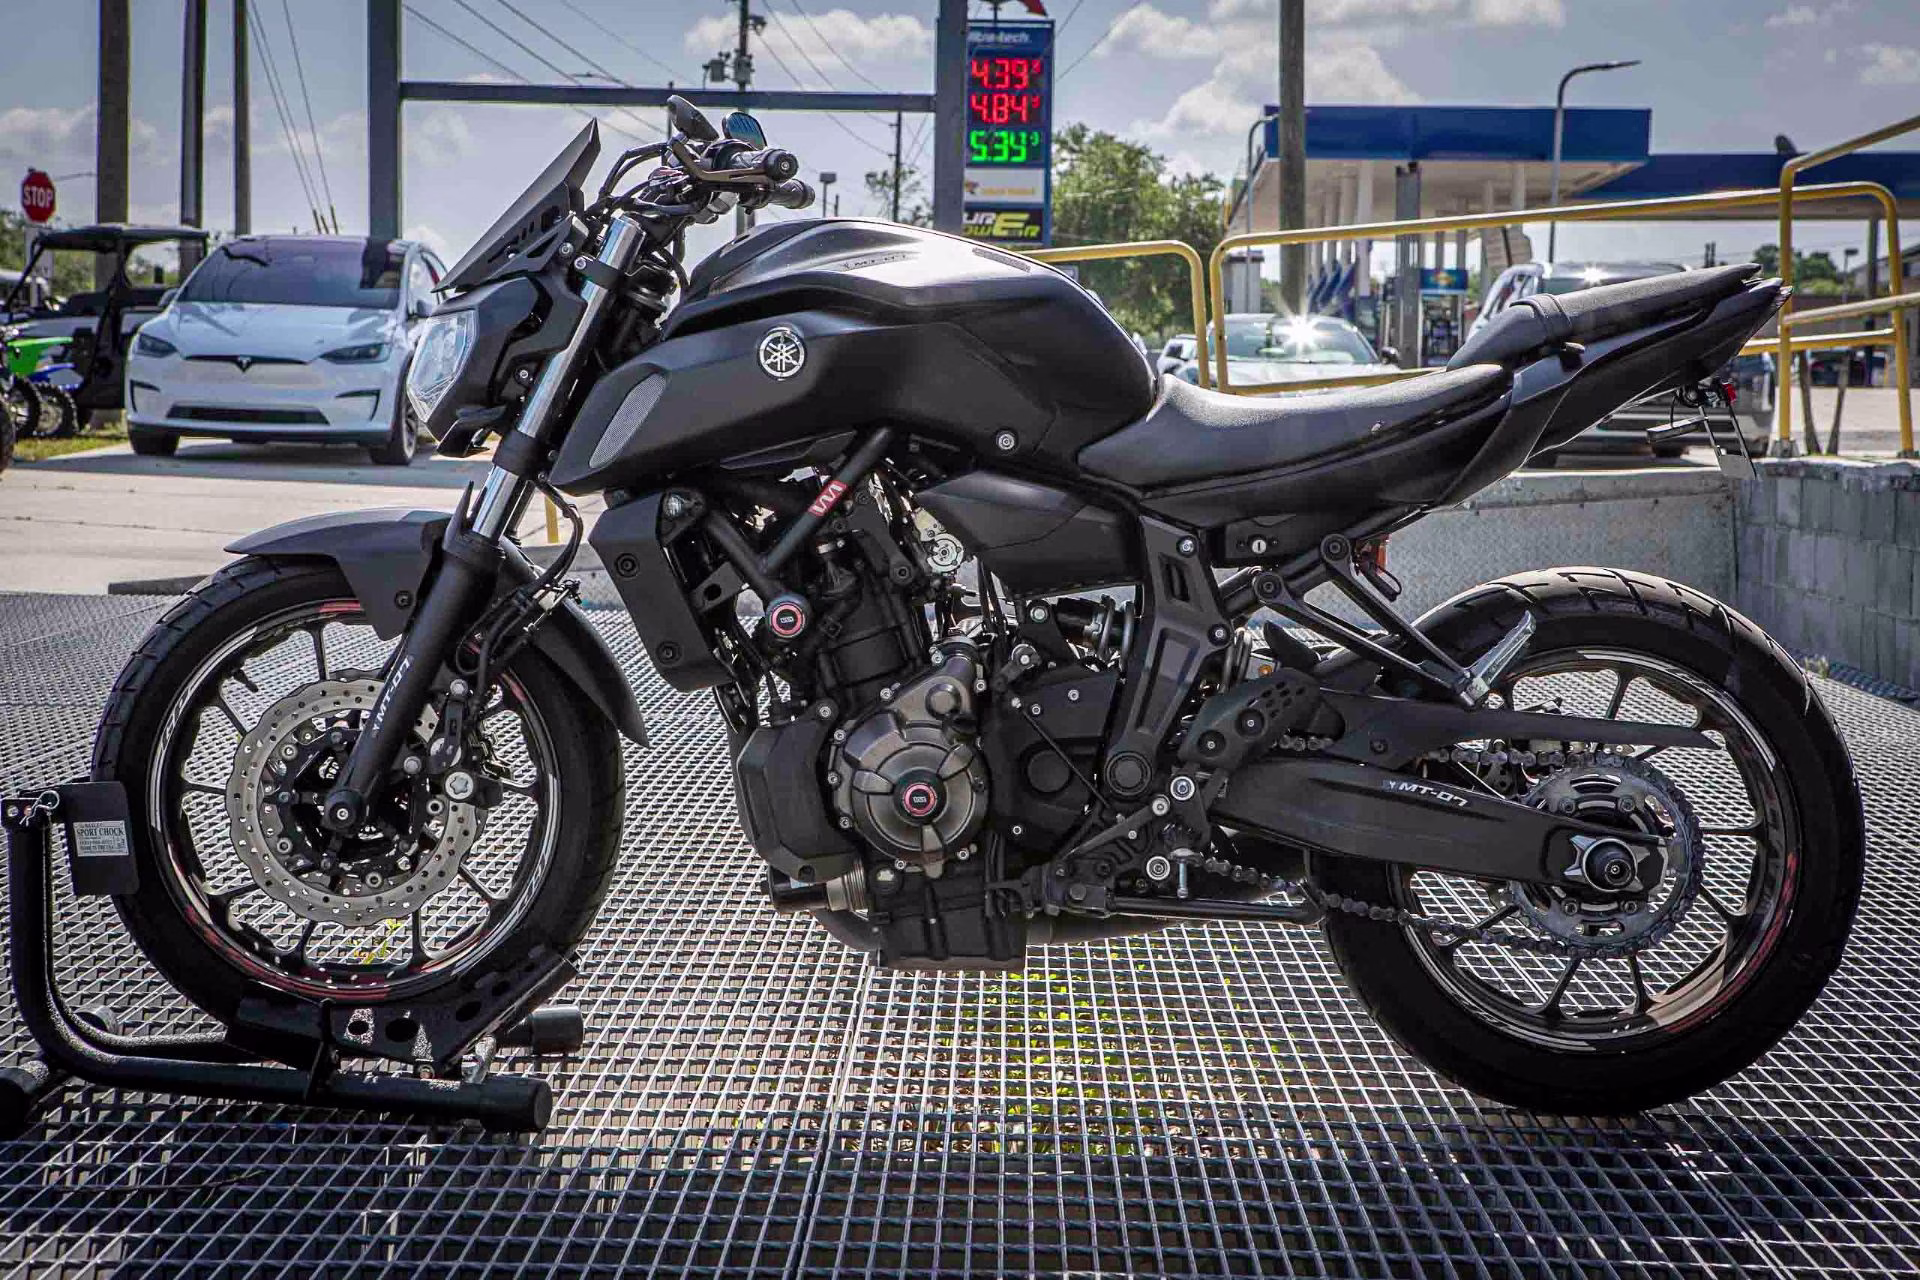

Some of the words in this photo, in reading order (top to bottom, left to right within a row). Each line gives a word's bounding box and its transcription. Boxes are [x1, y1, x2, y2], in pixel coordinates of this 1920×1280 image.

[23, 184, 54, 208] STOP
[77, 828, 97, 836] SPORT
[99, 827, 126, 836] CHOCK
